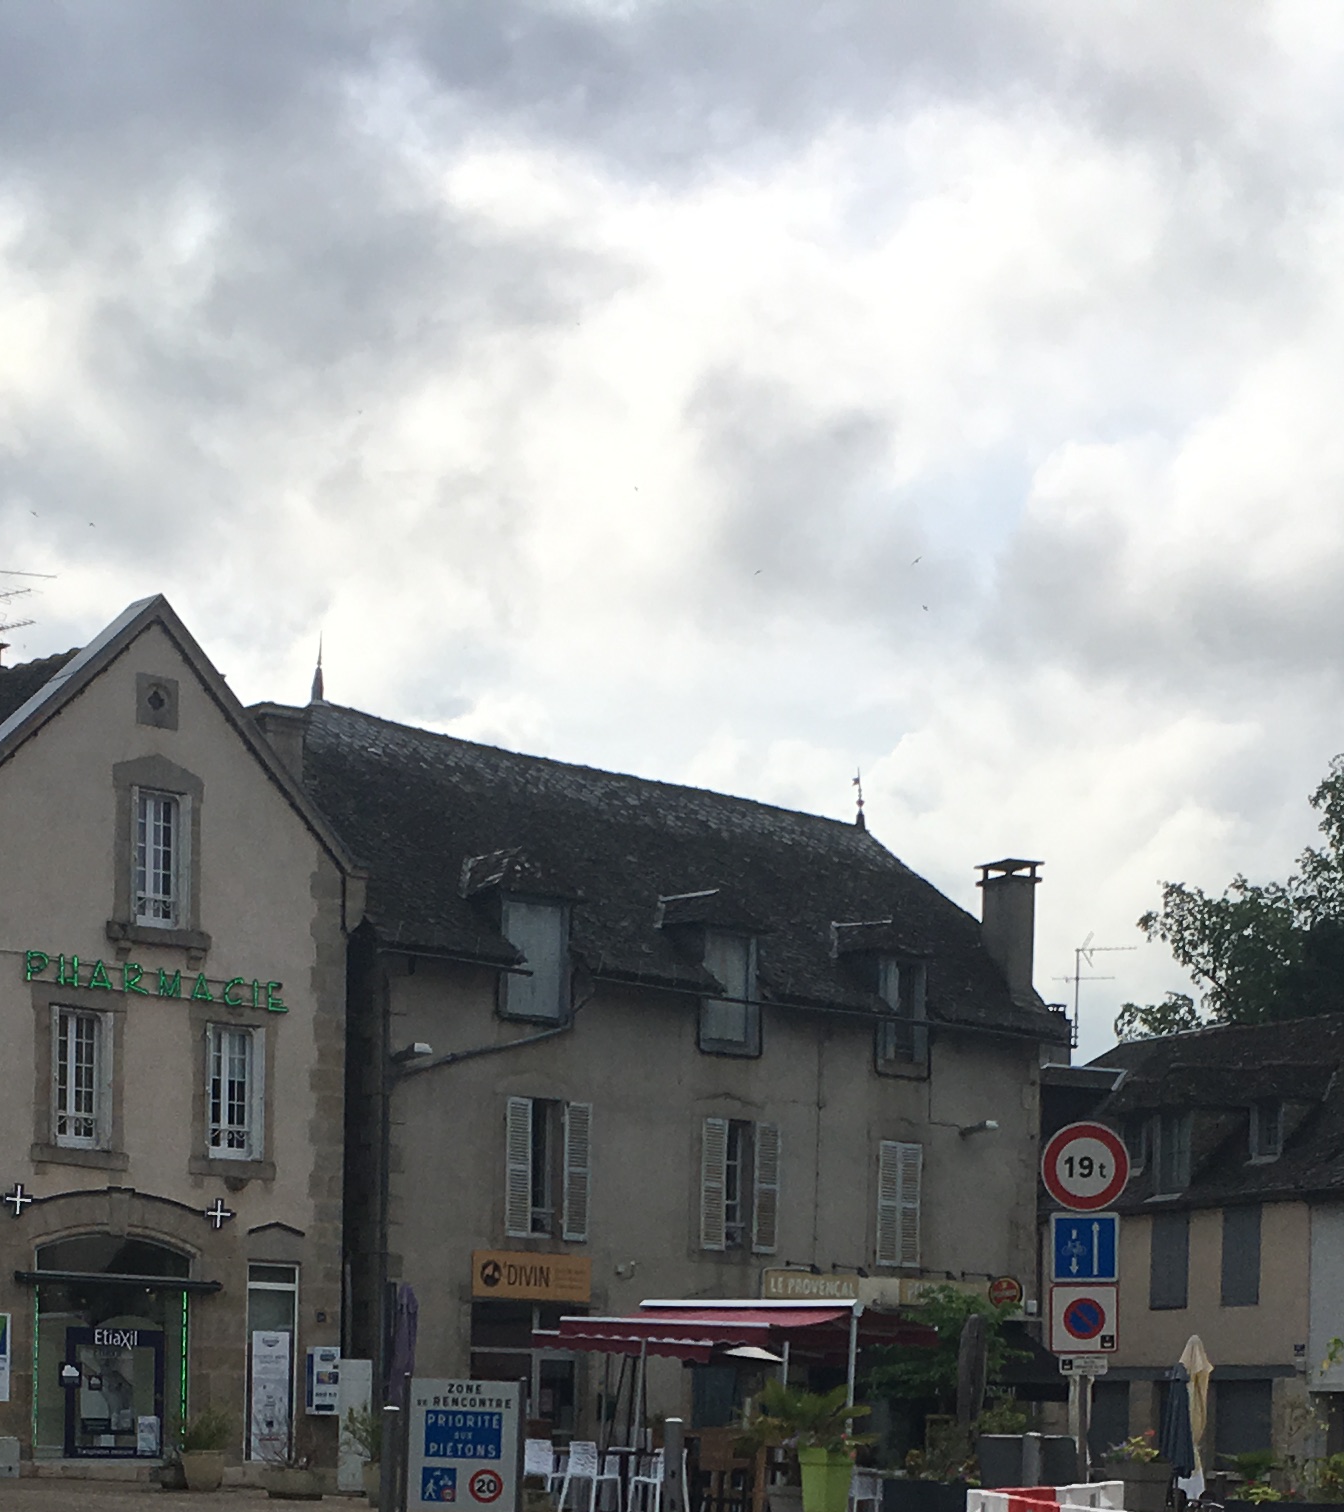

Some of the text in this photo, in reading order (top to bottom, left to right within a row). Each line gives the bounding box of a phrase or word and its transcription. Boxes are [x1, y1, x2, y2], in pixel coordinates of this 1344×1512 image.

[25, 949, 289, 1013] PHARMACIE
[1064, 1156, 1107, 1179] 19 t
[770, 1277, 783, 1294] LE
[447, 1383, 482, 1395] ZONE
[433, 1397, 511, 1409] RENCONTRE
[476, 1479, 497, 1493] 20
